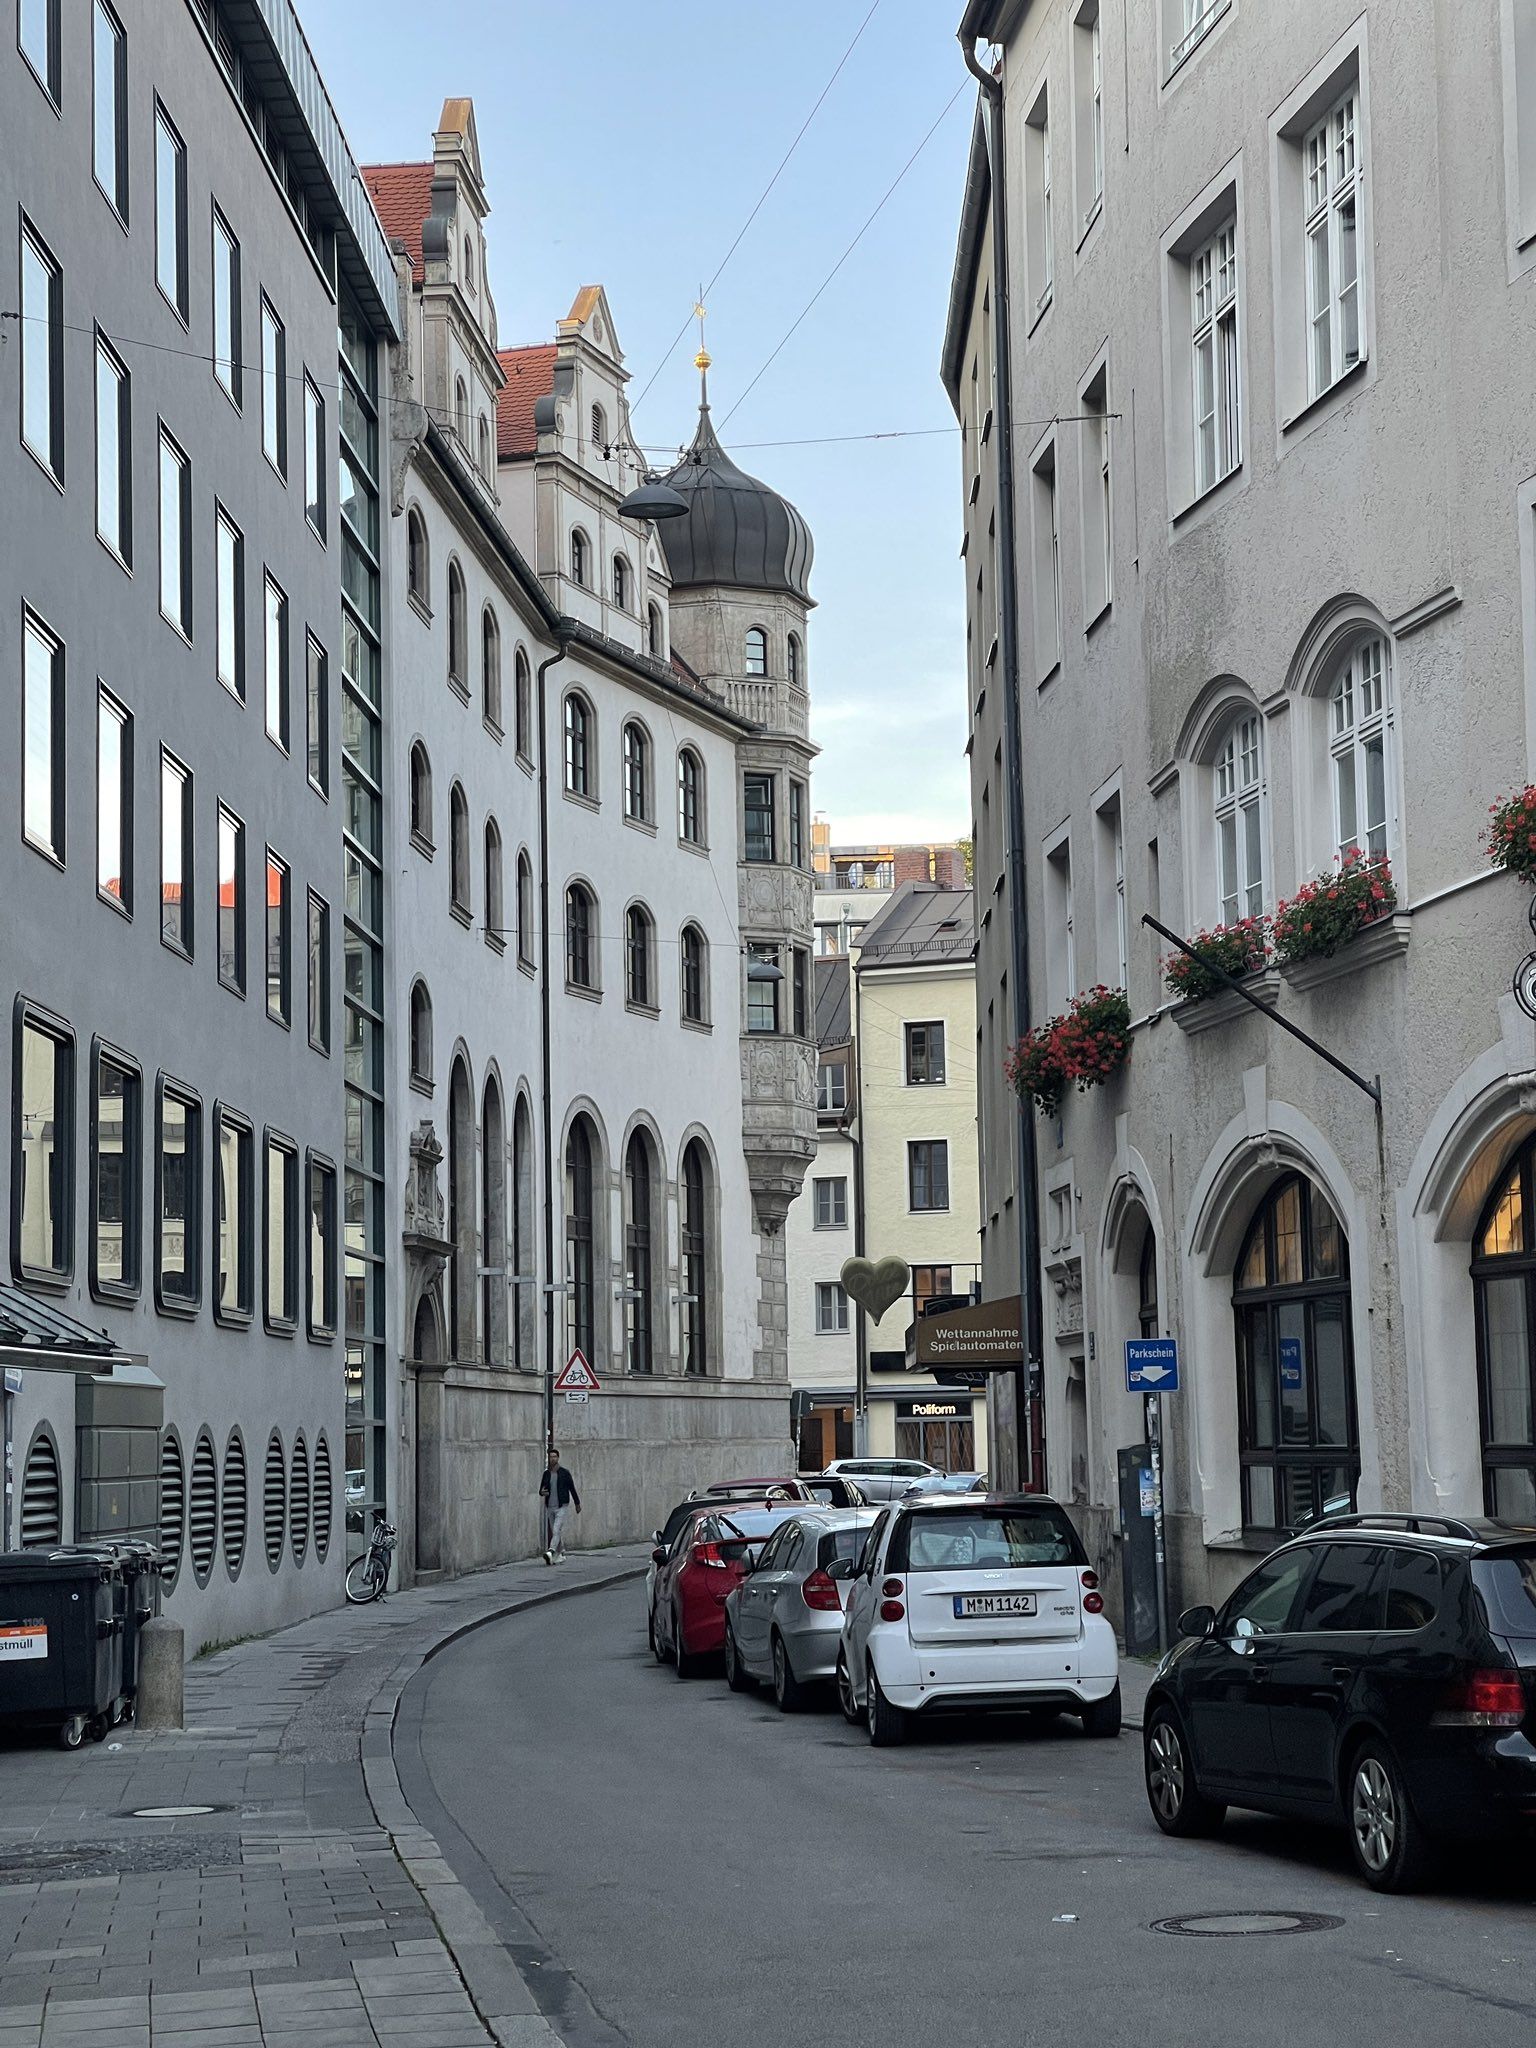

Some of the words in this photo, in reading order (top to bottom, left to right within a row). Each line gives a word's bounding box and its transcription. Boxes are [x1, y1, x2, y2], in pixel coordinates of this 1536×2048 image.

[936, 1328, 1019, 1339] Wettannahme
[1130, 1347, 1174, 1358] Parkschein
[912, 1403, 956, 1415] Poliform
